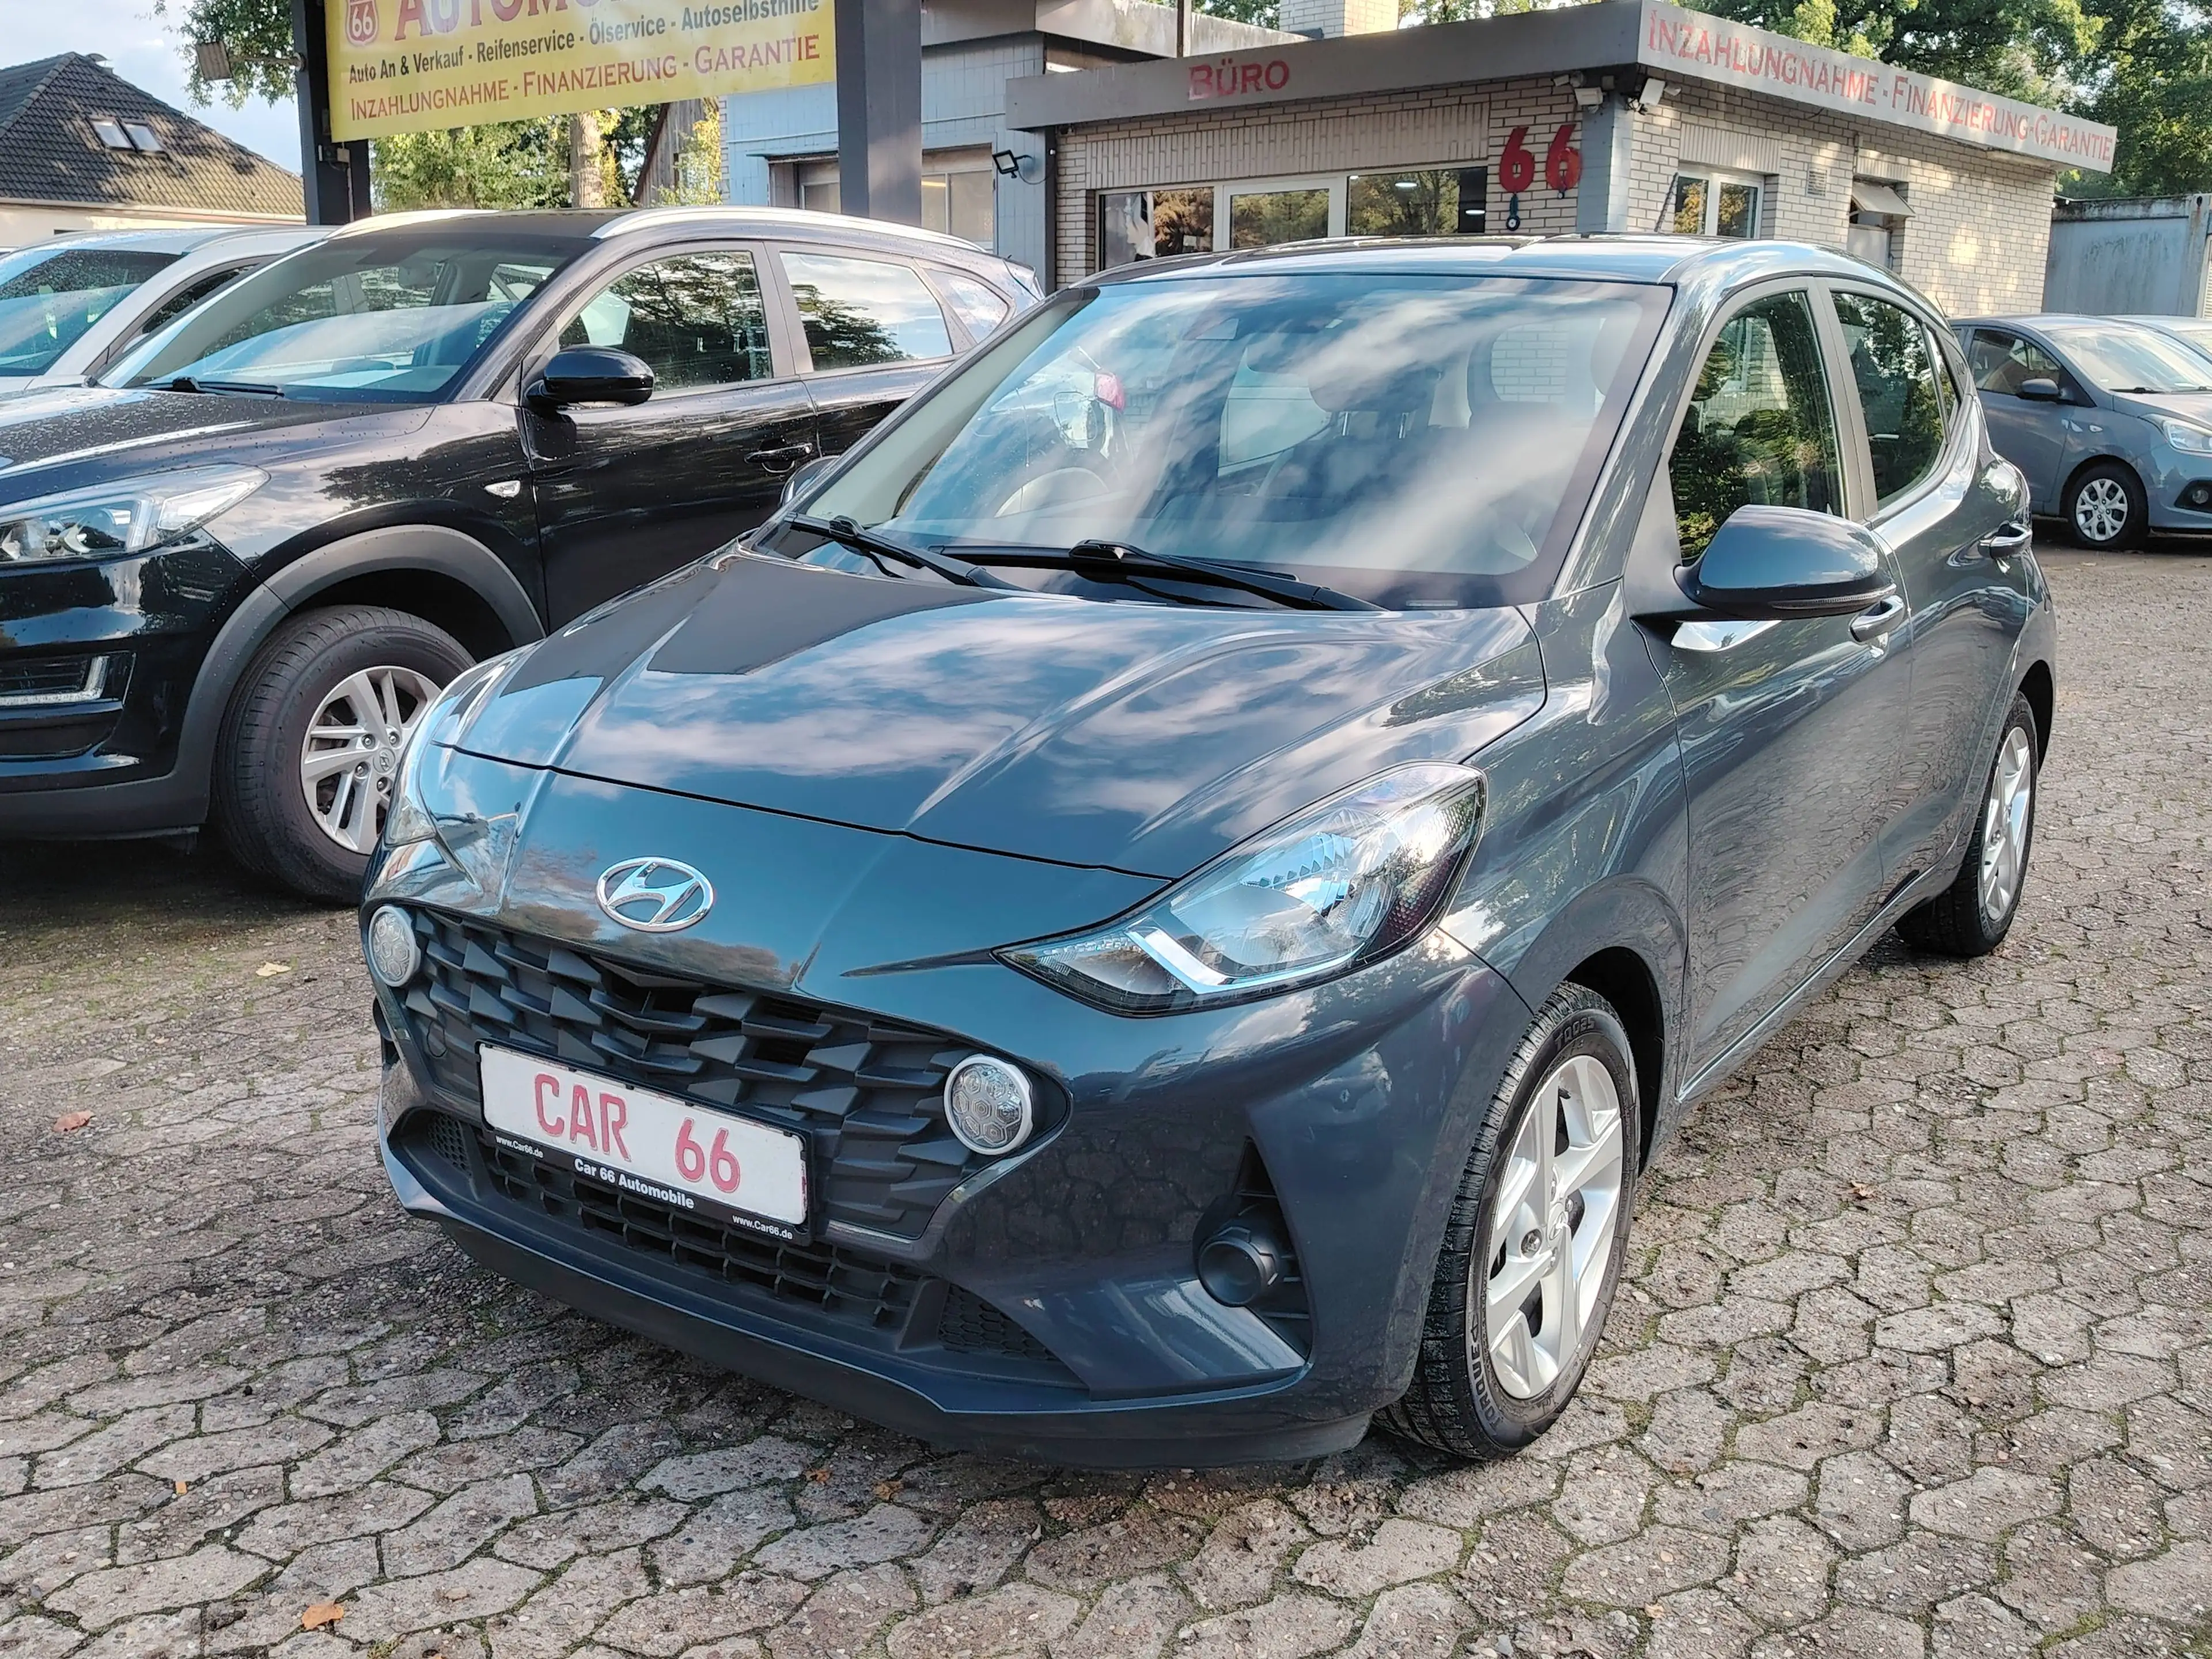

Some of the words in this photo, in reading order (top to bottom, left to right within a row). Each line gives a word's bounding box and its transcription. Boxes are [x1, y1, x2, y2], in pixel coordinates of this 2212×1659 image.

[351, 3, 373, 38] 66
[349, 65, 376, 84] Auto
[380, 59, 396, 79] An
[401, 55, 410, 75] &
[413, 45, 464, 73] Verkauf
[476, 32, 575, 63] Reifenservice
[589, 14, 666, 45] Ölservice
[1188, 58, 1290, 101] BÜRO
[1499, 124, 1582, 193] 66
[495, 1135, 544, 1158] www.Car66.de
[534, 1072, 632, 1162] CAR
[675, 1116, 741, 1194] 66
[574, 1158, 597, 1177] Car
[599, 1168, 615, 1184] 66
[618, 1173, 695, 1210] Automobile
[732, 1214, 793, 1240] www.Car66.de
